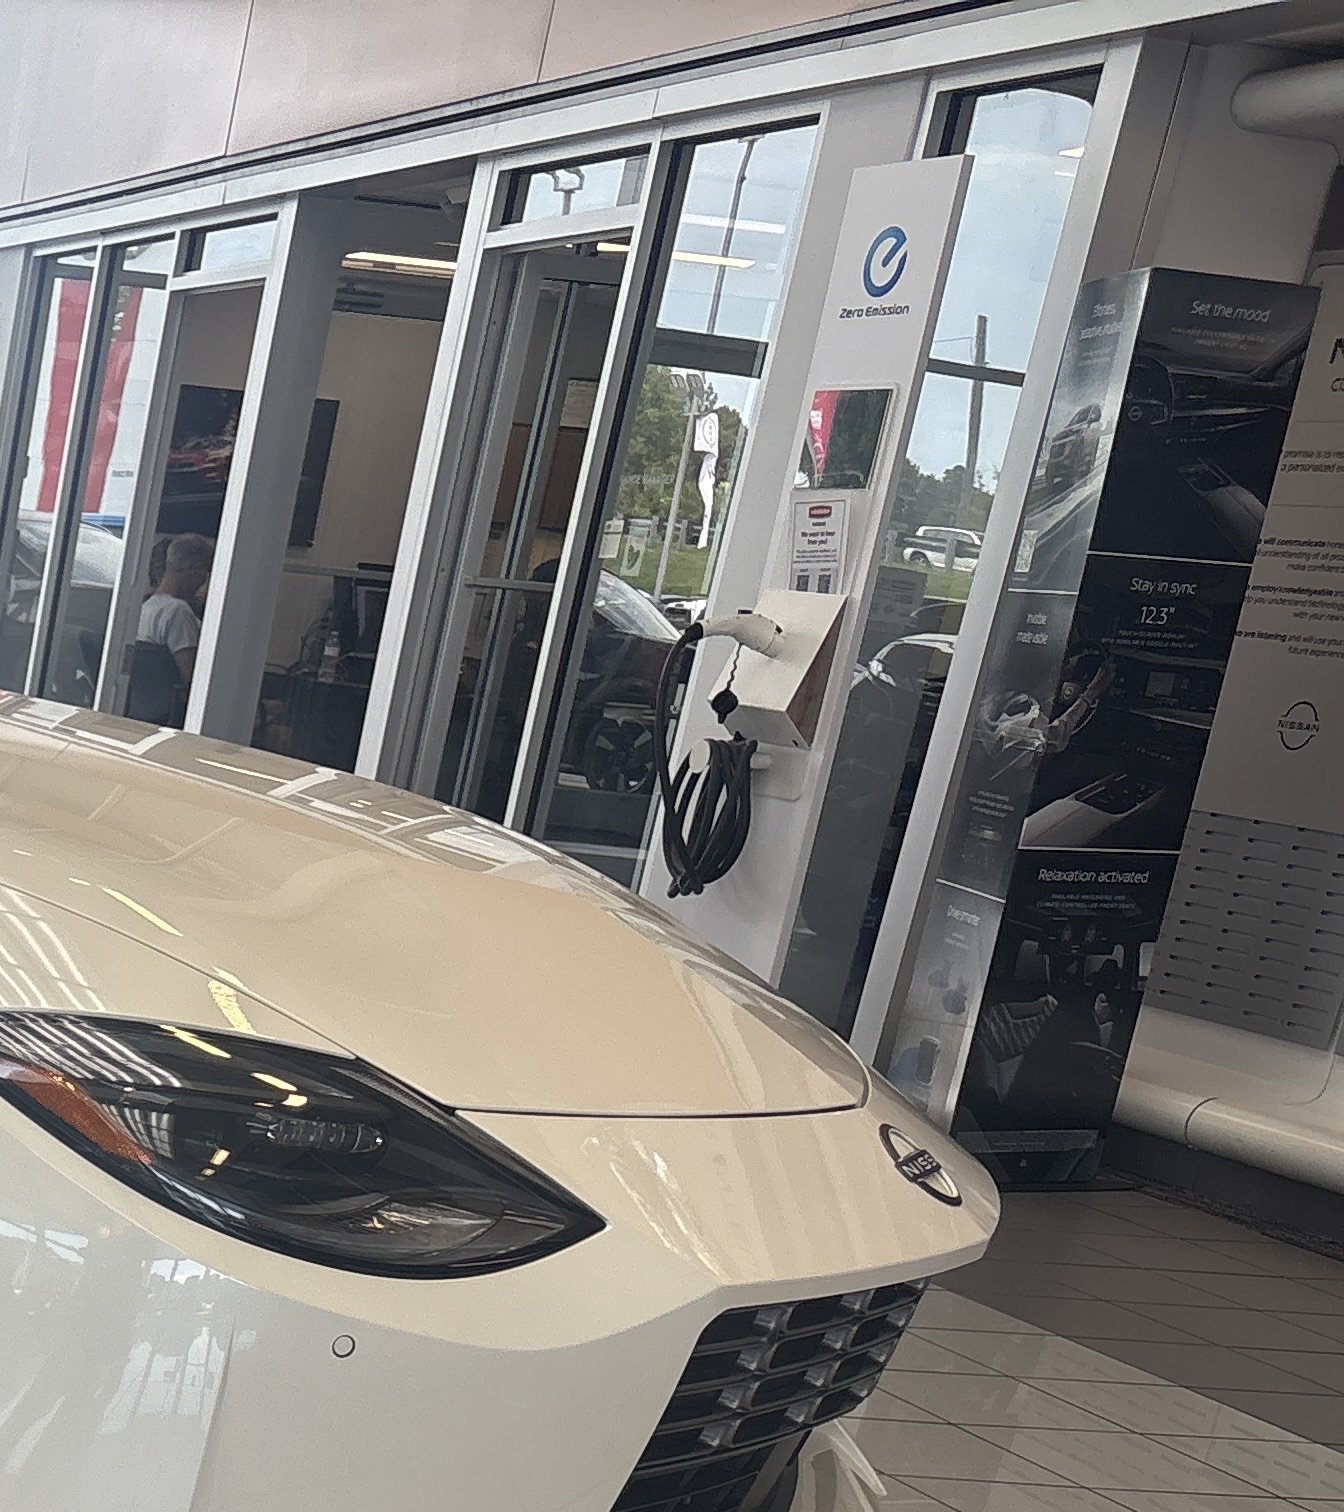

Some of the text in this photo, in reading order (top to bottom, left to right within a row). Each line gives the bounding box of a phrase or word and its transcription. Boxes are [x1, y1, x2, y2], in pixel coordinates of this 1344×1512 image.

[839, 304, 910, 319] Zero Emission
[1190, 300, 1272, 323] Set the mood
[1130, 578, 1198, 596] Stay in sync
[1277, 719, 1320, 732] NISSAN
[1038, 868, 1151, 884] Relaxation activated
